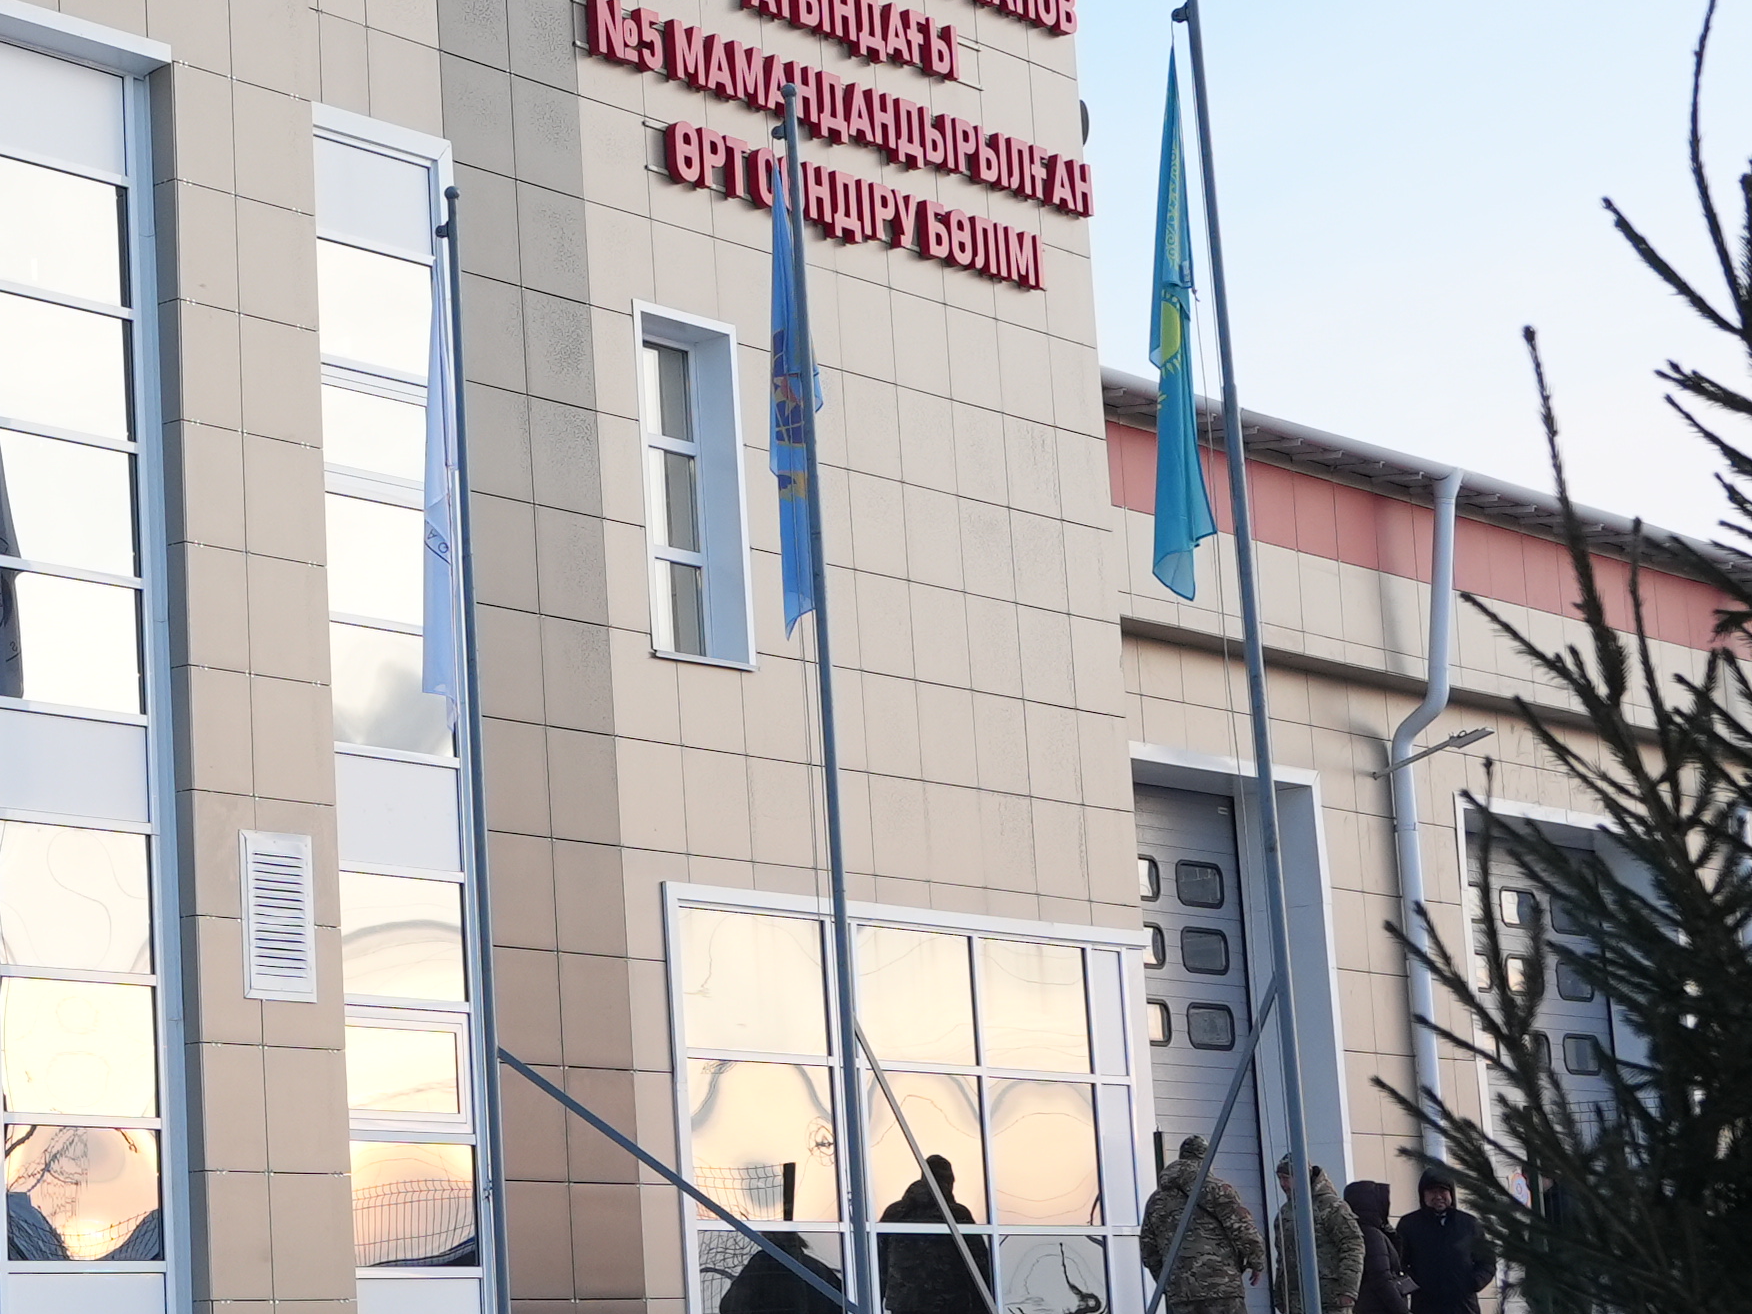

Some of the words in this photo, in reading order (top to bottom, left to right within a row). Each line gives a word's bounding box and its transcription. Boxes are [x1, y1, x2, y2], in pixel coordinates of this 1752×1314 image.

[664, 18, 1094, 218] МАМАНДАНДЫРЫЛҒАН
[664, 120, 748, 199] ӨРТ
[916, 198, 1046, 292] БӨЛІМІ
